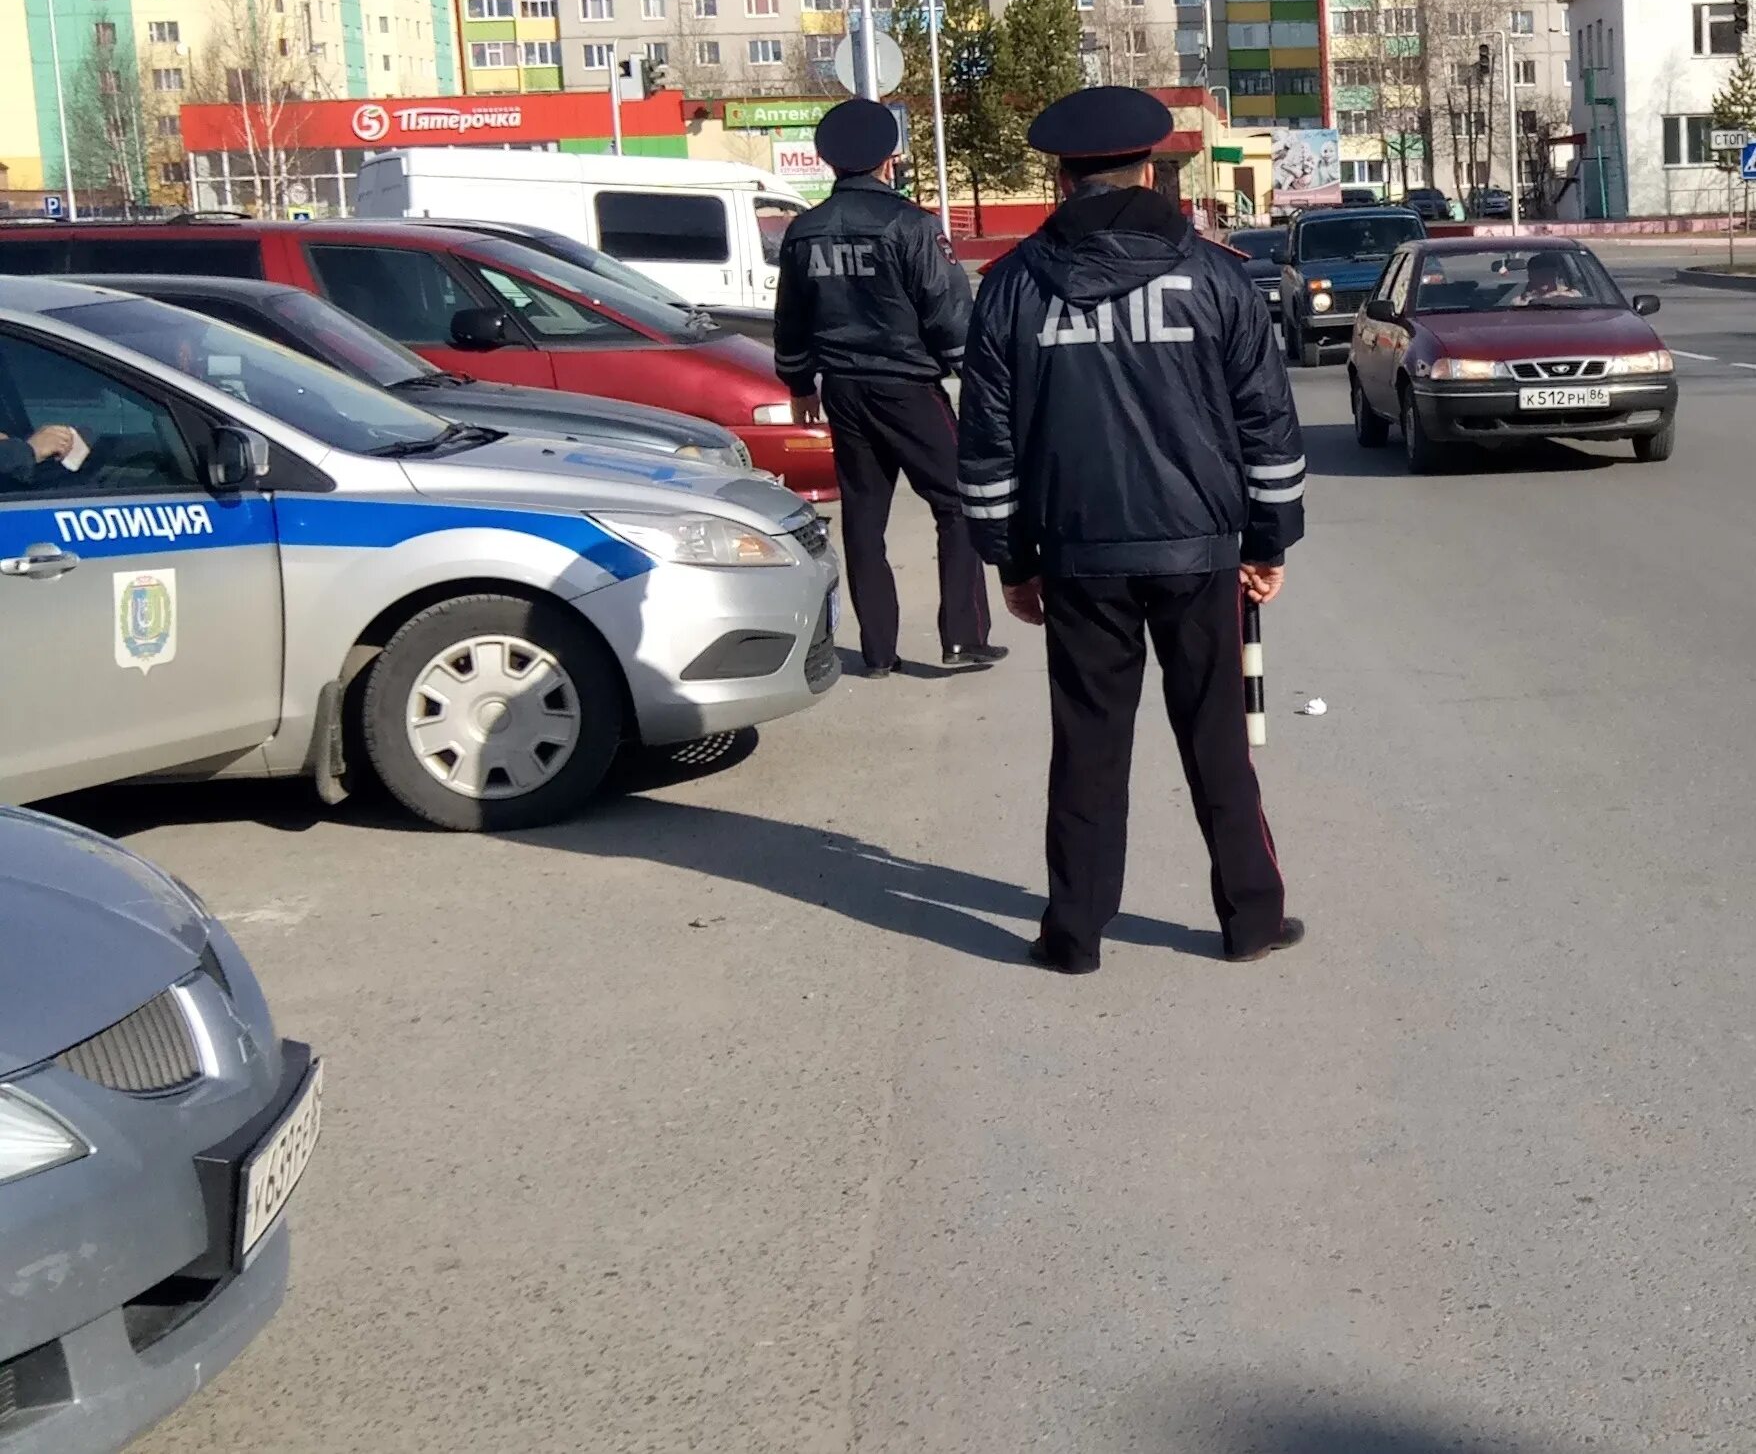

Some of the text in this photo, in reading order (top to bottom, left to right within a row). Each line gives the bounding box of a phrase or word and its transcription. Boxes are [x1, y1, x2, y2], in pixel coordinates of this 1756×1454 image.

[393, 107, 521, 133] Пятерочка
[1715, 133, 1744, 146] СТОП
[780, 152, 820, 167] МЫ
[807, 244, 876, 278] ДПС
[1036, 274, 1195, 347] ДПС
[54, 504, 213, 542] ПОЛИЦИЯ
